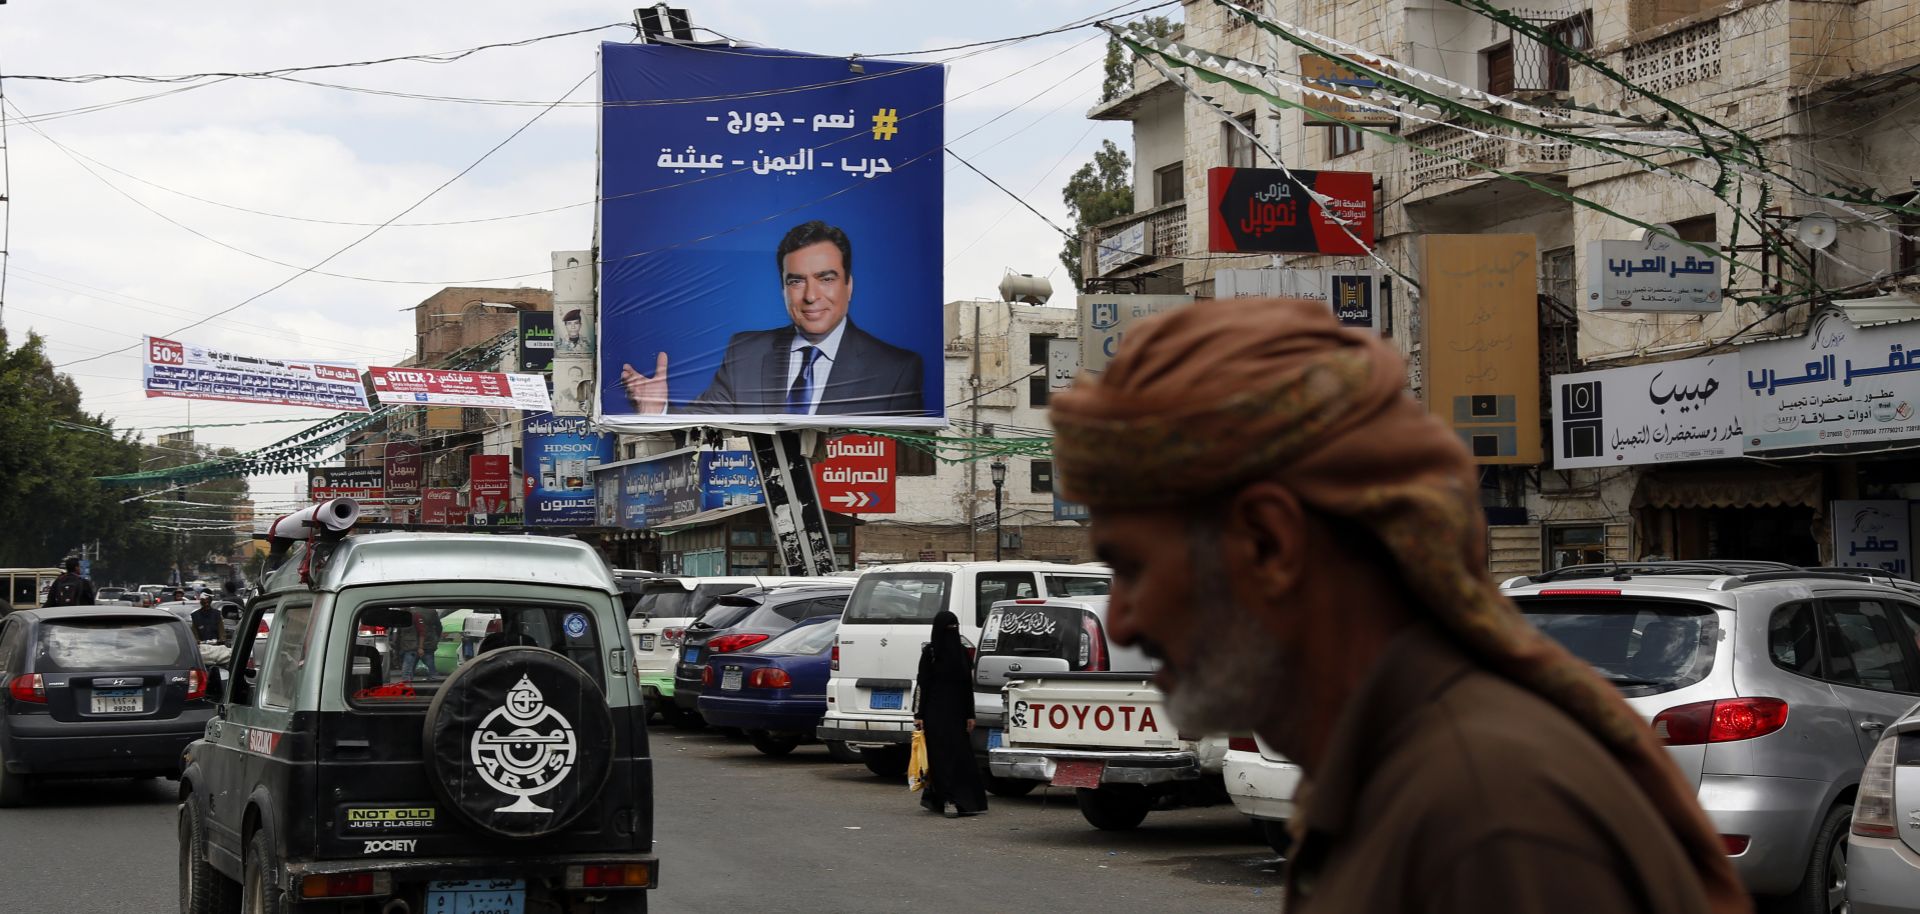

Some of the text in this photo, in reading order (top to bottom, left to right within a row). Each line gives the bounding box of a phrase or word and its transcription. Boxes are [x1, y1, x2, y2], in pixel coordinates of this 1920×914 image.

[727, 110, 785, 134] جورج
[813, 109, 855, 132] نعم
[872, 108, 898, 141] #
[656, 146, 724, 174] عبثية
[752, 148, 814, 175] اليمن
[841, 157, 892, 178] حرب
[1241, 196, 1297, 238] تحويل
[1608, 255, 1714, 278] صقر العرب
[1337, 309, 1368, 321] الحزمي
[152, 346, 183, 363] 50%
[317, 367, 335, 377] سارة
[335, 369, 356, 380] بشرى
[387, 371, 426, 383] SITEX
[1747, 343, 1920, 396] صقر العرب
[1778, 398, 1808, 411] تجميل
[1810, 394, 1853, 408] مستحضرات
[1863, 389, 1895, 402] عطور
[1801, 406, 1872, 425] أدوات حلاقة
[1611, 423, 1650, 450] التجميل
[1720, 415, 1744, 441] طور
[543, 443, 593, 452] HDSON
[825, 440, 885, 458] النعمان
[708, 454, 748, 474] السوداني
[822, 466, 888, 485] للصرافة
[314, 488, 370, 499] السوداني
[1848, 536, 1898, 556] صقر
[1029, 703, 1158, 733] TOYOTA
[250, 729, 273, 755] SUZUKI
[481, 753, 565, 788] ARTS
[352, 809, 430, 819] NOT OLD
[363, 839, 418, 854] ZOCIETY
